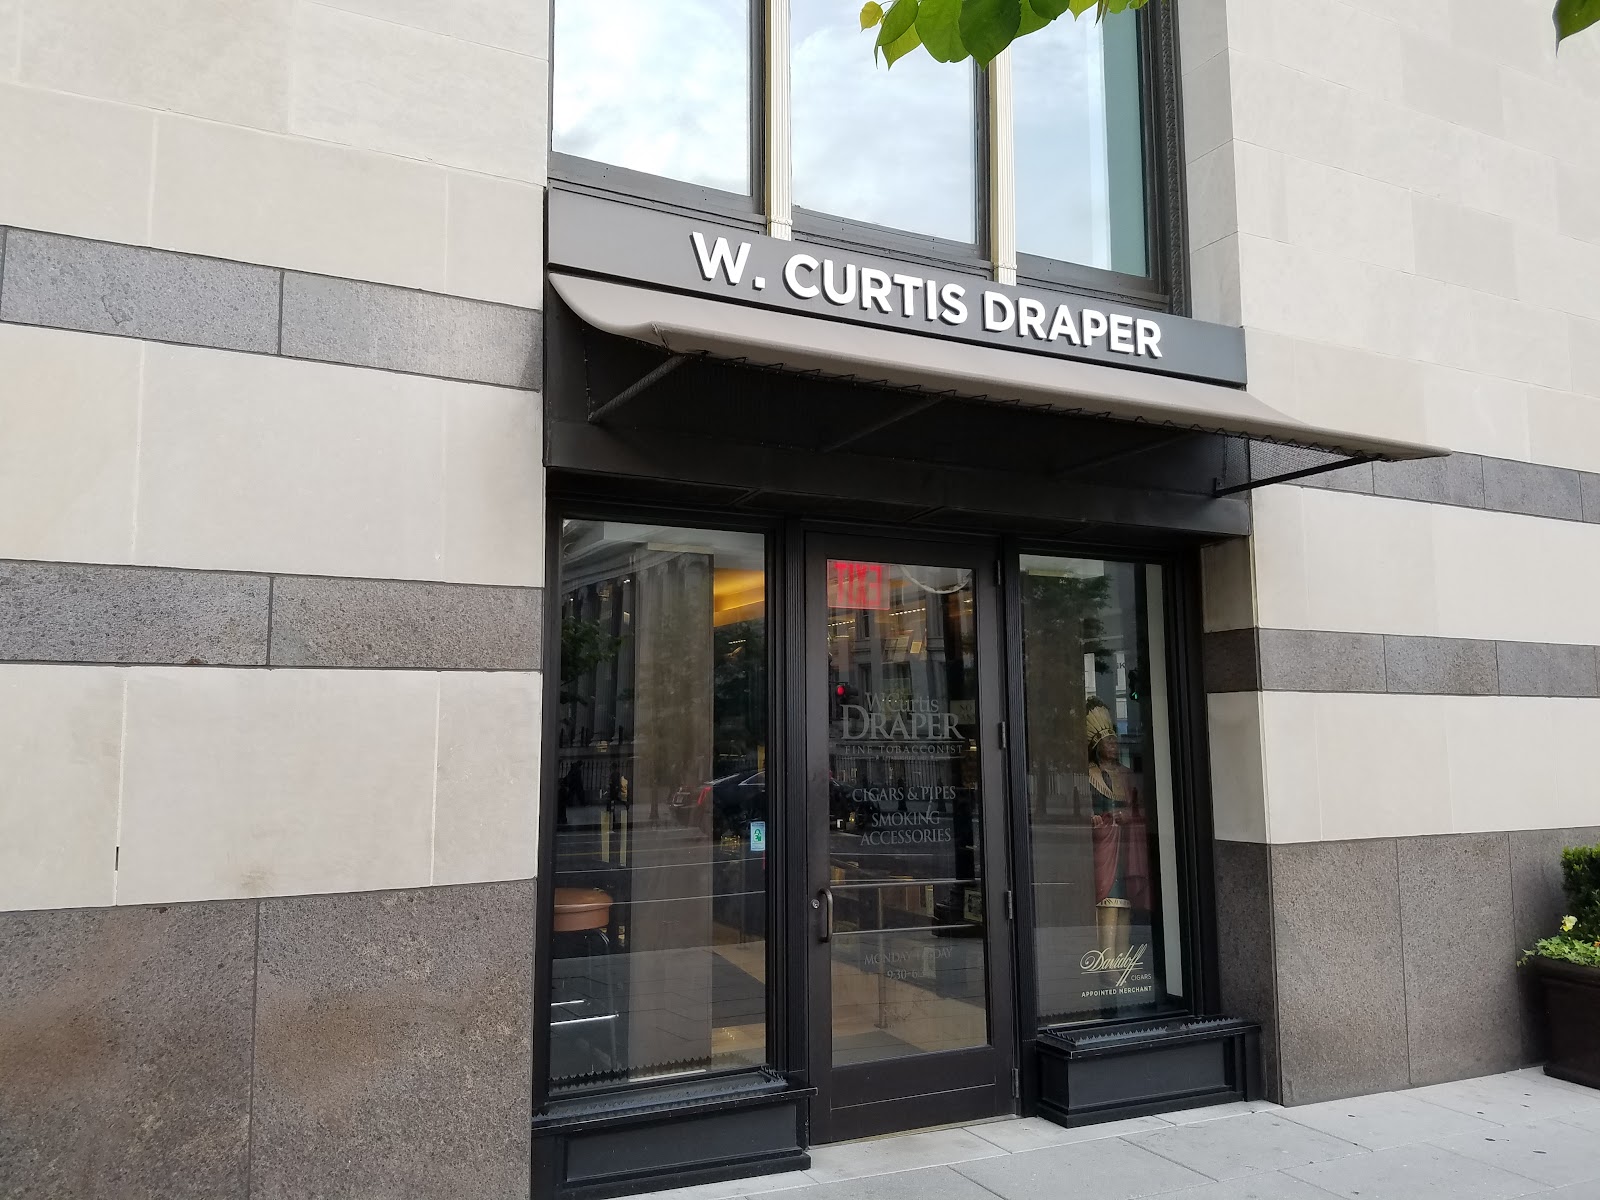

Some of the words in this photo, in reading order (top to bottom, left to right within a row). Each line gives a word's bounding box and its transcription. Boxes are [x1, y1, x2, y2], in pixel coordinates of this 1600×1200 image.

[691, 231, 766, 289] W.
[782, 253, 968, 326] CURTIS
[983, 290, 1163, 359] DRAPER
[839, 704, 965, 740] DRAPER
[845, 745, 873, 755] FINE
[878, 744, 963, 755] TOBACCONIST
[852, 786, 904, 802] CIGARS
[907, 786, 918, 800] &
[920, 785, 956, 800] PIPES
[871, 811, 940, 828] SMOKING
[860, 828, 951, 846] ACCESSORIES
[1080, 943, 1147, 987] Davidoff
[1131, 973, 1152, 981] CIGARS
[1081, 988, 1117, 998] APPOINTED
[1118, 985, 1152, 995] MERCHANT
